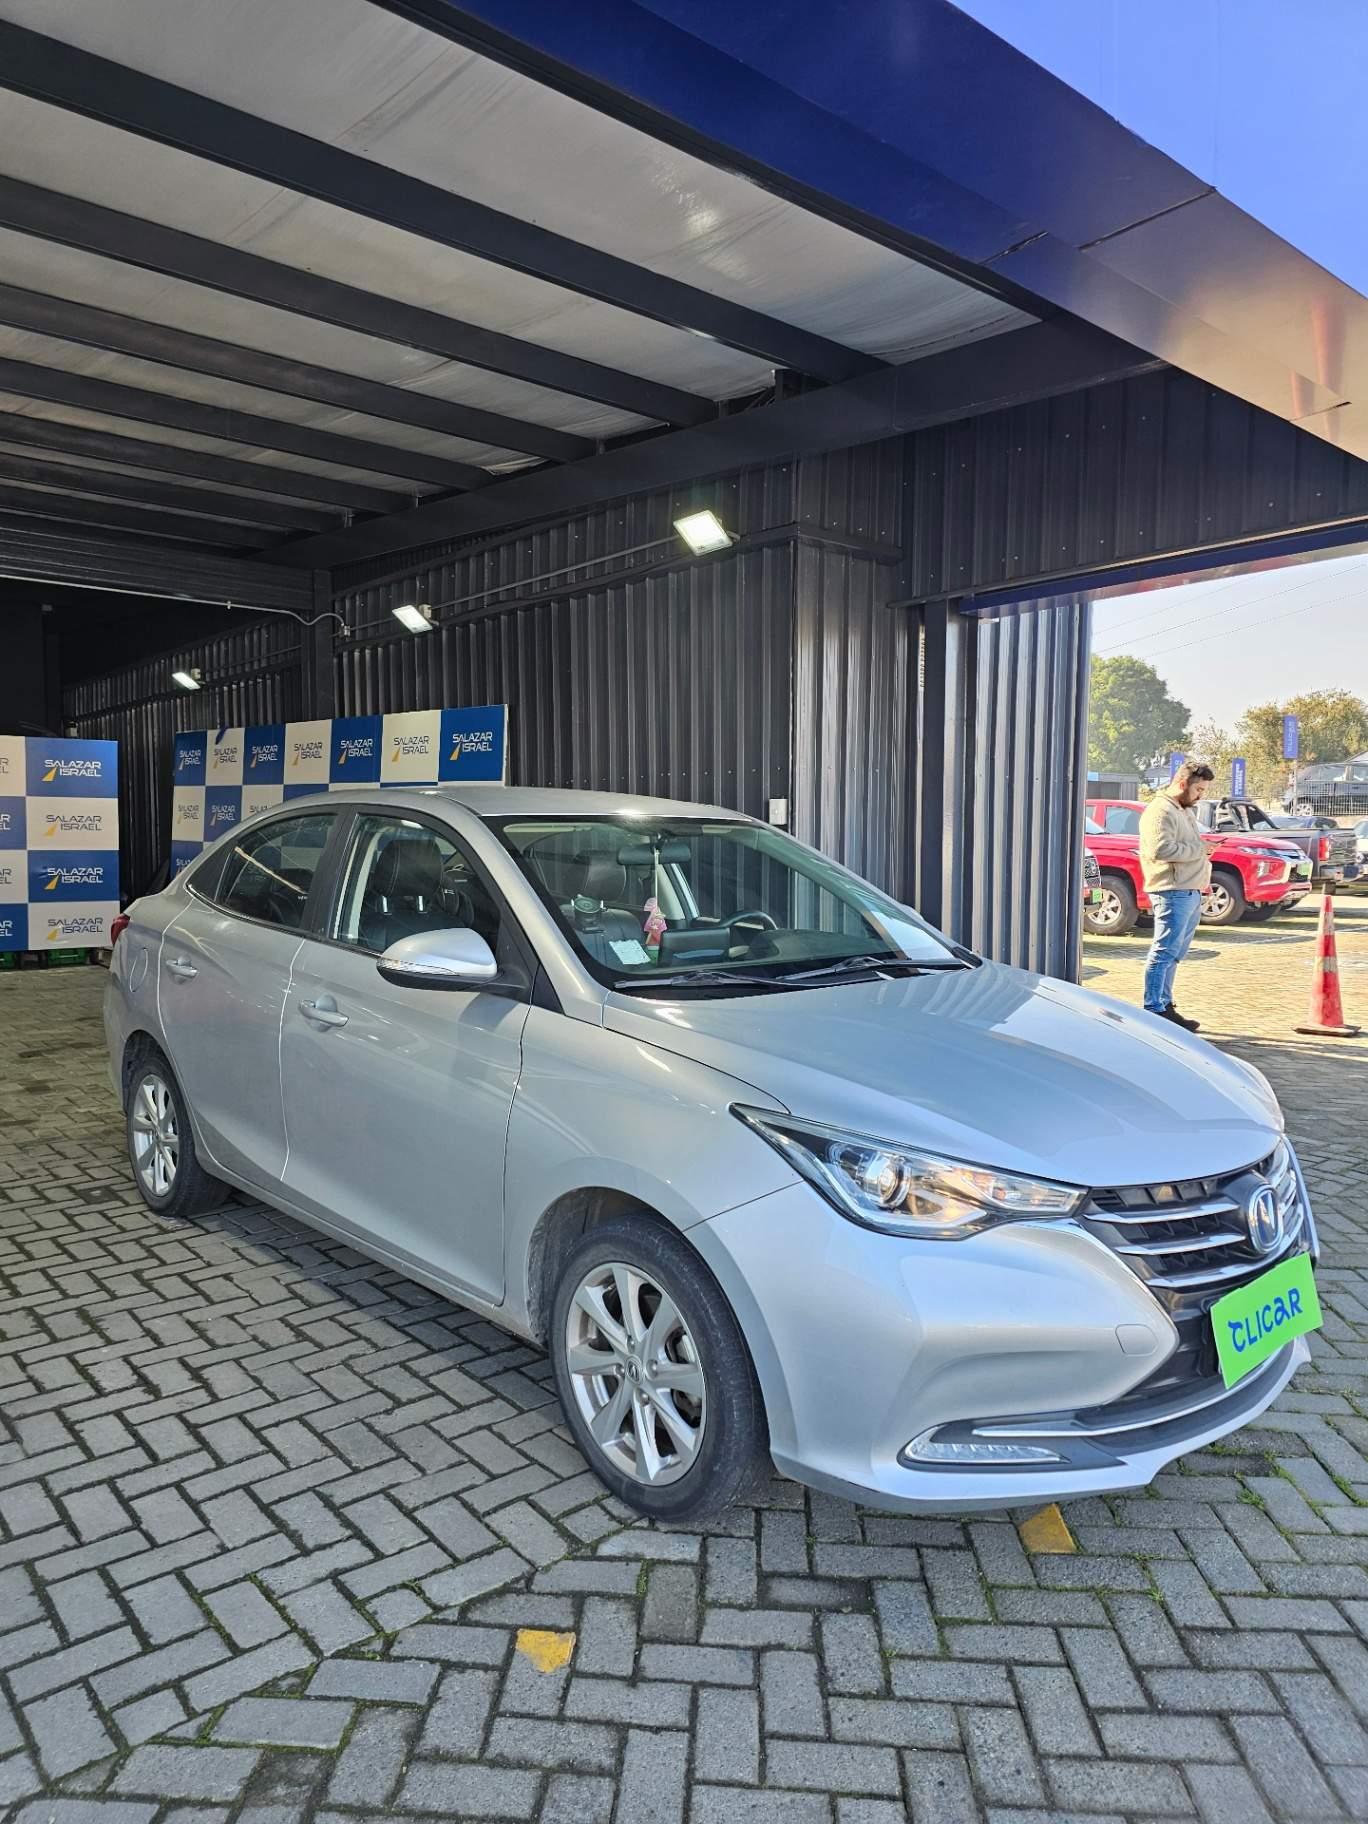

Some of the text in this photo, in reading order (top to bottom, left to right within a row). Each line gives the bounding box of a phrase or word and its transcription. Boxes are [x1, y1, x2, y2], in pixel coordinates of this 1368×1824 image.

[393, 735, 430, 746] SALAZAR
[452, 731, 493, 743] SALAZAR
[294, 742, 323, 752] SALAZAR
[340, 738, 374, 748] SALAZAR
[462, 742, 493, 752] ISRAEL
[252, 744, 279, 754] SALAZAR
[348, 747, 373, 757] ISRAEL
[402, 745, 429, 755] ISRAEL
[258, 753, 278, 762] ISRAEL
[300, 751, 323, 760] ISRAEL
[44, 760, 102, 769] SALAZAR
[59, 769, 102, 777] ISRAEL
[46, 815, 102, 823] SALAZAR
[60, 823, 102, 831] ISRAEL
[47, 867, 104, 876] SALAZAR
[47, 917, 104, 927] SALAZAR
[62, 926, 104, 934] ISRAEL
